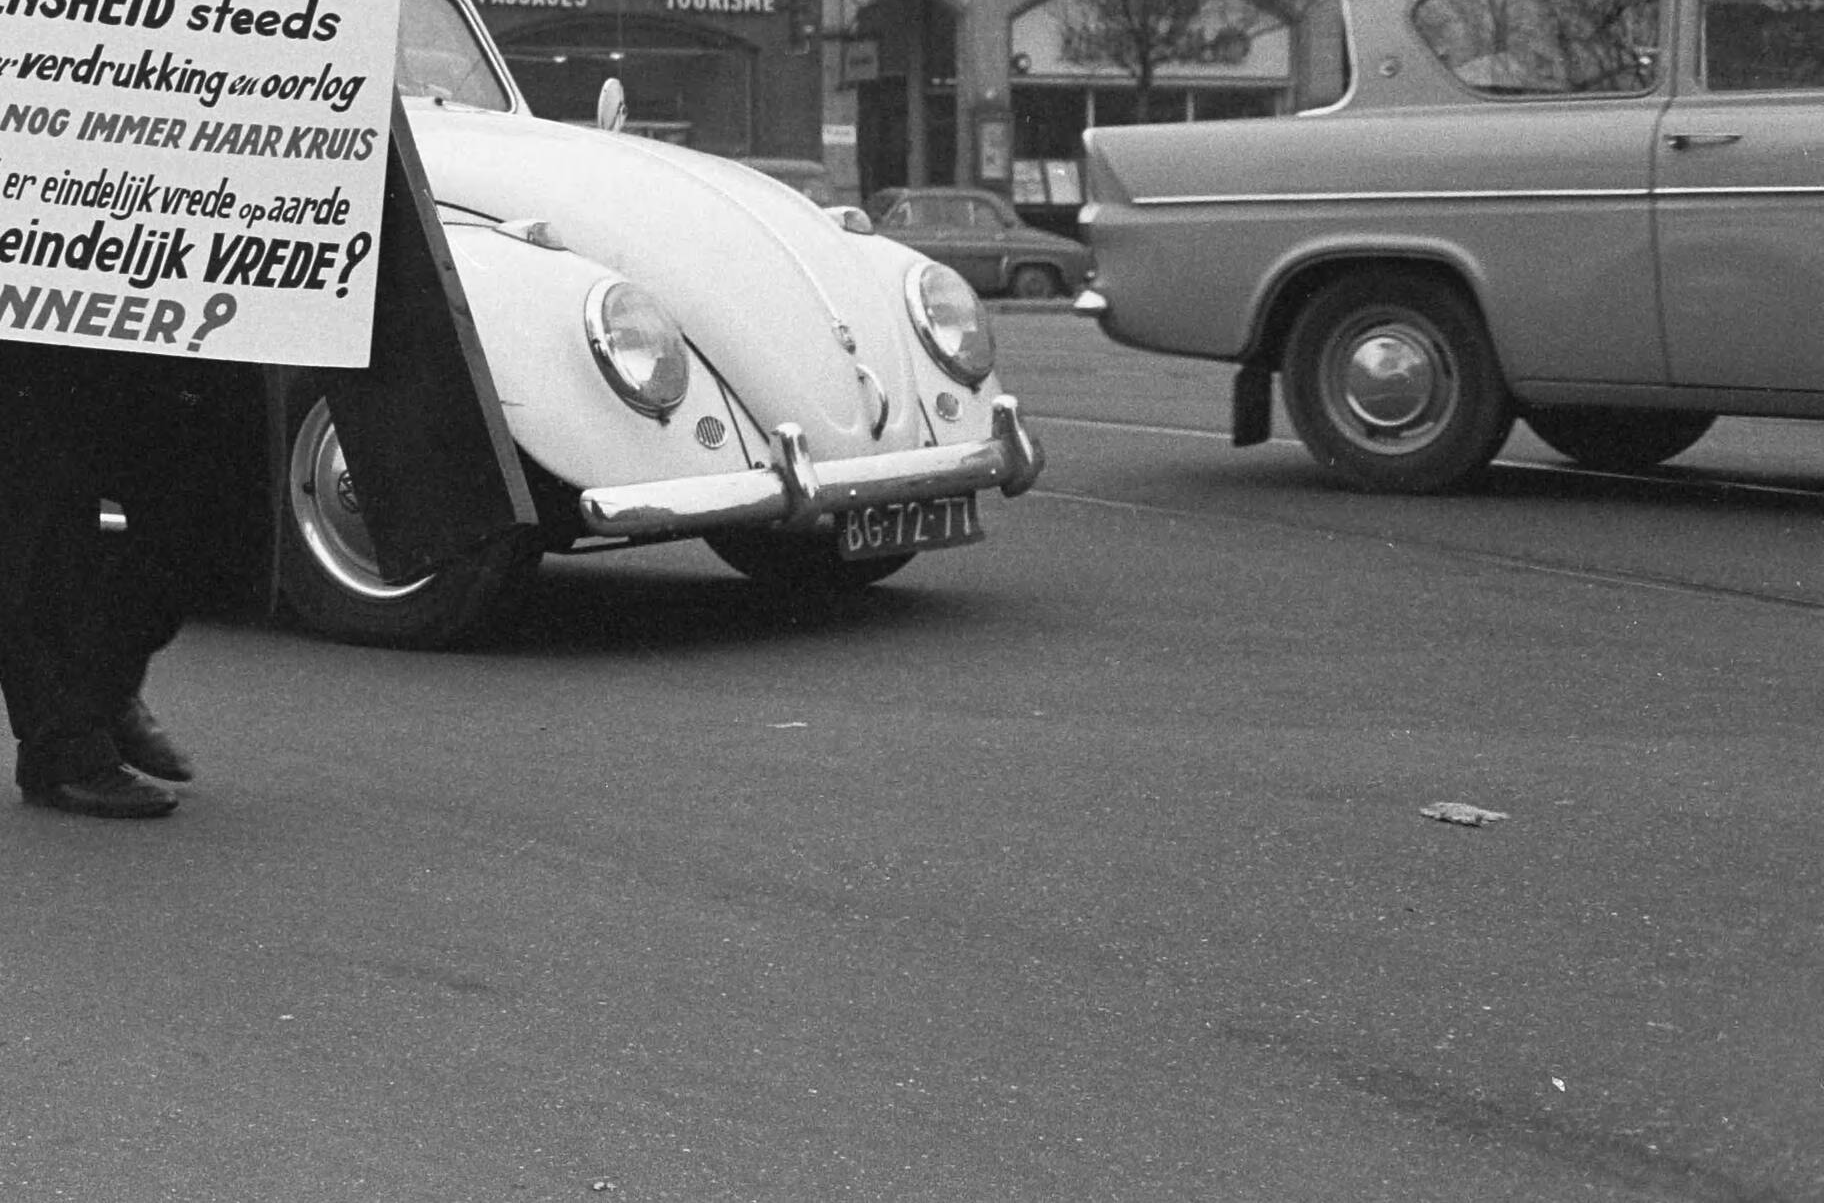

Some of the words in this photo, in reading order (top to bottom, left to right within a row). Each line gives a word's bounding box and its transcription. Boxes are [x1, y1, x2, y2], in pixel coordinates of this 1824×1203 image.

[17, 44, 229, 108] verdrukking
[228, 75, 260, 96] en
[261, 63, 366, 112] oorlog
[77, 111, 186, 149] IMMER
[189, 121, 283, 157] HAAR
[283, 126, 378, 161] KRUIS
[3, 173, 37, 200] er
[41, 168, 161, 220] eindelijk
[160, 177, 236, 218] vrede
[239, 204, 266, 229] op
[267, 186, 350, 225] aarde
[203, 231, 372, 298] VREDE?
